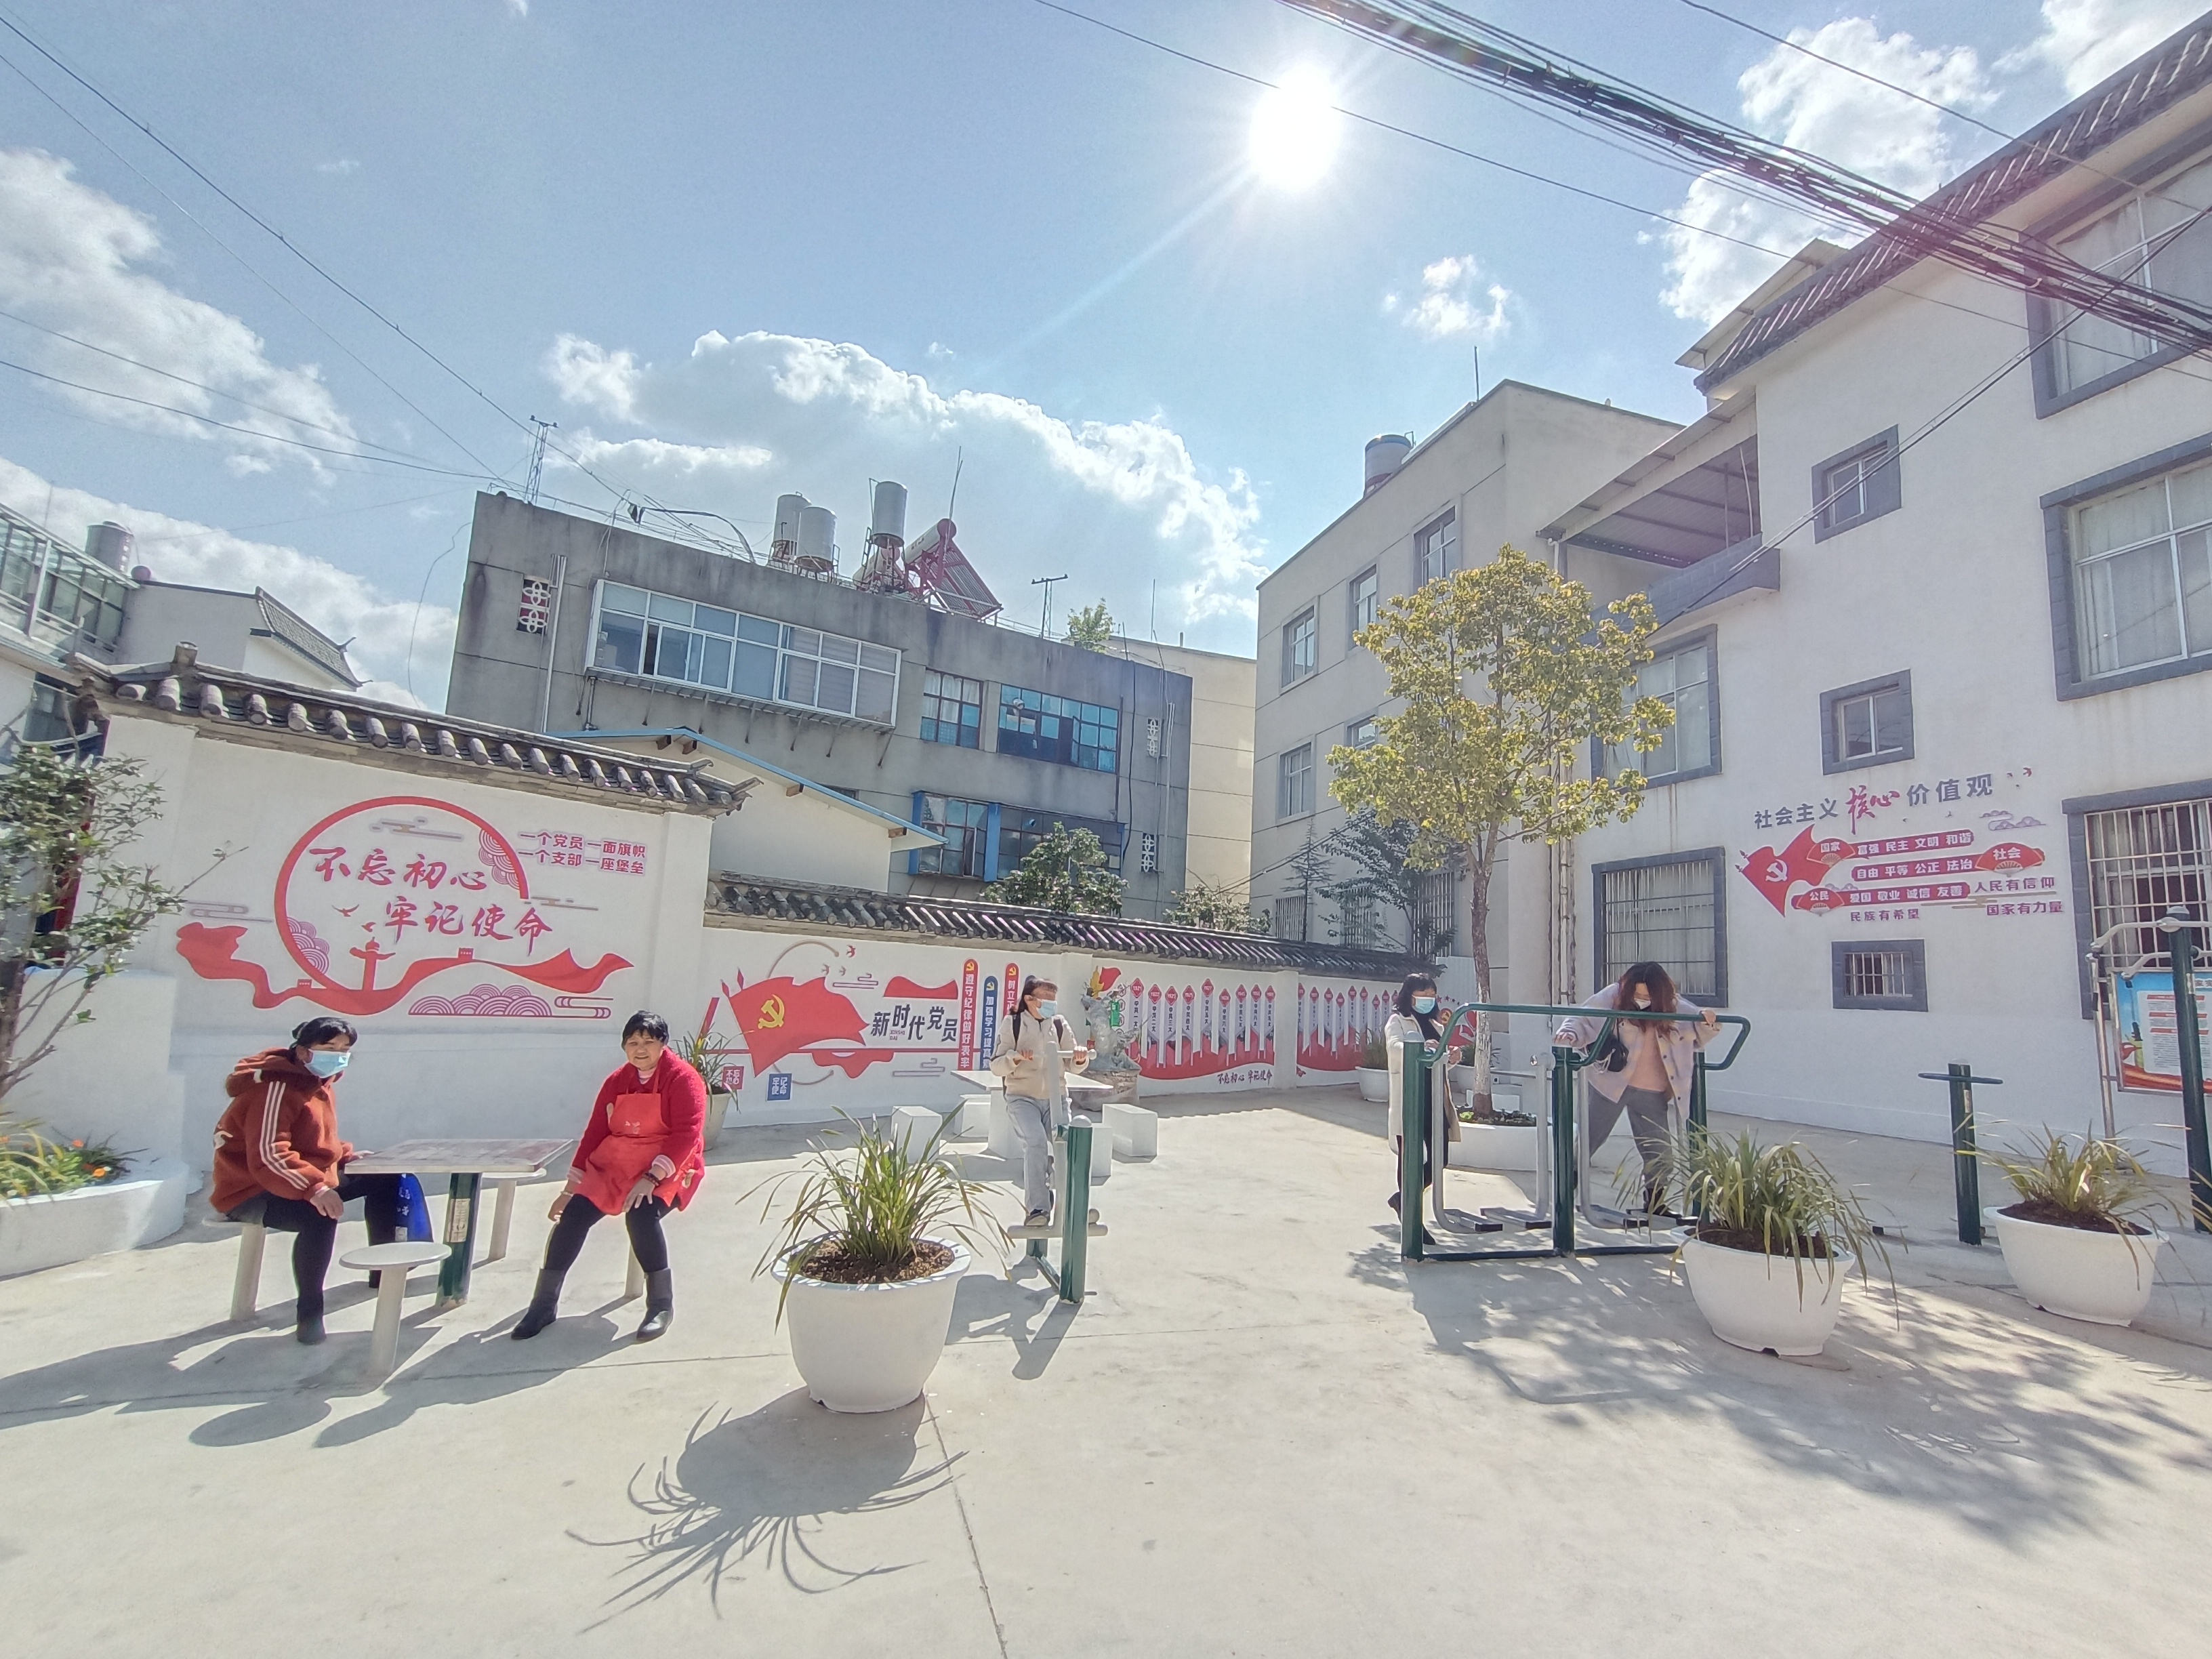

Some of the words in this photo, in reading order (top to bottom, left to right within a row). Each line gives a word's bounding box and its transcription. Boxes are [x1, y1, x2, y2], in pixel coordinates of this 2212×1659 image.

[1754, 798, 1839, 830] 社会主义
[1844, 785, 1901, 835] 核心
[1906, 773, 1993, 807] 价值观
[520, 832, 583, 850] 一个党员
[587, 840, 646, 859] 一面旗帜
[1820, 842, 1841, 853] 国家
[1857, 844, 1880, 855] 富强
[1885, 840, 1909, 852] 民主
[1914, 836, 1939, 848] 文明
[1946, 832, 1972, 845] 和谐
[518, 849, 582, 866] 一个支部
[585, 858, 644, 874] 一座堡垒
[1992, 847, 2021, 861] 社会
[309, 847, 488, 891] 不忘初心
[1857, 867, 1879, 879] 自由
[1885, 865, 1908, 877] 平等
[1914, 861, 1940, 874] 公正
[1946, 859, 1973, 872] 法治
[1849, 892, 1872, 903] 爱国
[1877, 890, 1900, 901] 敬业
[1906, 887, 1931, 899] 诚信
[1937, 885, 1963, 897] 友善
[1974, 876, 2055, 893] 人民有信仰
[1809, 890, 1829, 901] 公民
[1850, 909, 1920, 922] 民族有希望
[1986, 901, 2064, 916] 国家有力量
[384, 895, 554, 956] 牢记使命
[870, 1004, 958, 1042] 新时代党员
